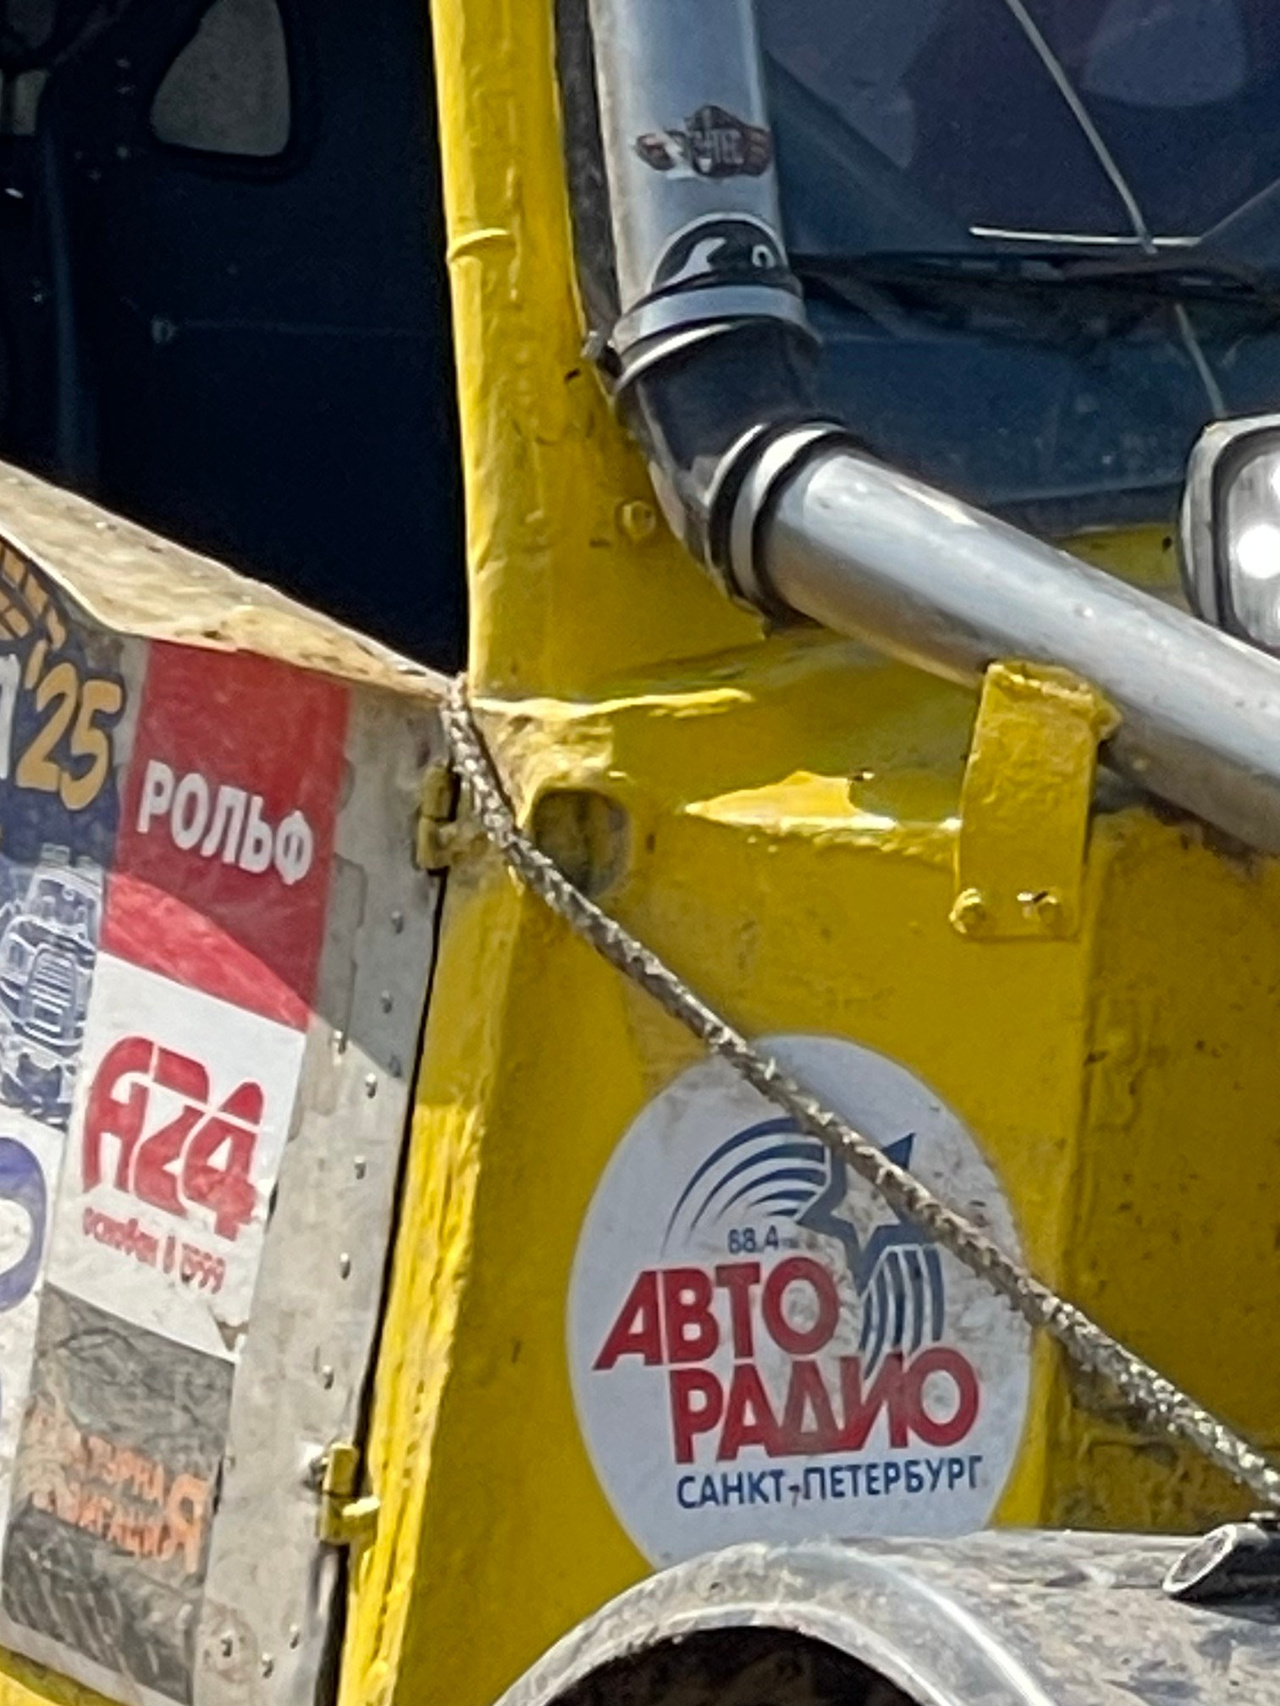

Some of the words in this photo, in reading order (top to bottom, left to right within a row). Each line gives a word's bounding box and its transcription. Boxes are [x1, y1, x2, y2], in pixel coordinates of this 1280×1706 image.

[136, 760, 316, 886] РОЛЬФ
[592, 1256, 841, 1371] АВТО
[668, 1346, 979, 1464] РАДИО
[677, 1454, 985, 1509] САНКТ-ПЕТЕРБУРГ
